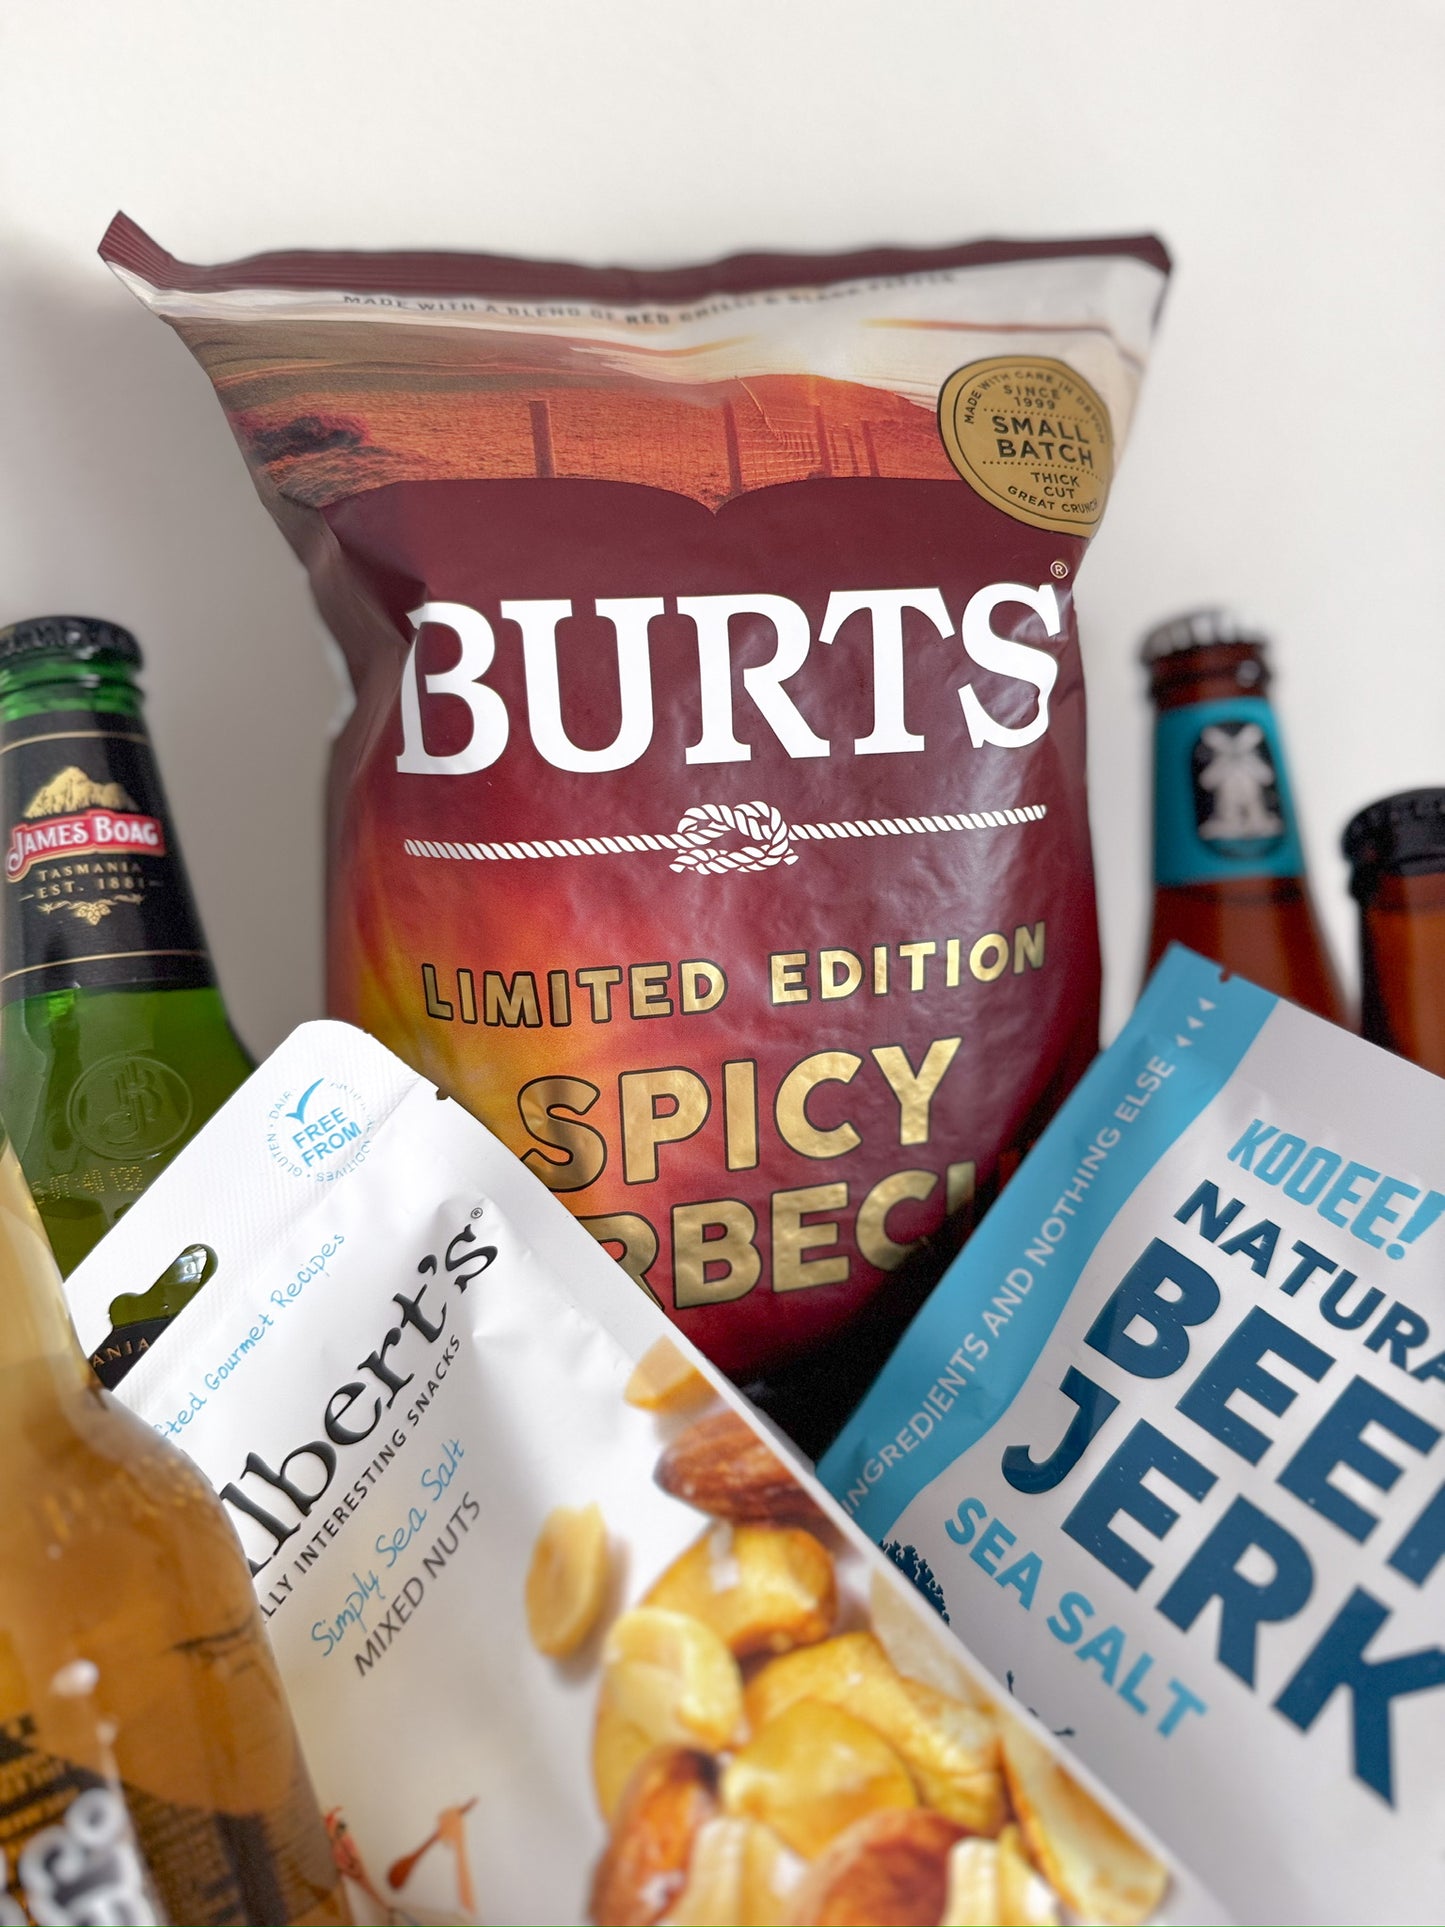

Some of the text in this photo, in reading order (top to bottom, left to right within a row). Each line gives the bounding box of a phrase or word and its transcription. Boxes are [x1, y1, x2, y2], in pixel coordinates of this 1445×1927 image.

[343, 295, 409, 310] MADE
[418, 302, 475, 312] WITH
[485, 304, 499, 313] A
[626, 312, 670, 325] RED
[964, 390, 982, 425] MADE
[978, 371, 1011, 391] WITH
[1014, 371, 1053, 382] CARE
[1058, 380, 1074, 395] IN
[1003, 384, 1061, 400] SINCE
[1014, 396, 1056, 410] 1999
[992, 414, 1090, 445] SMALL
[996, 438, 1094, 469] BATCH
[1007, 485, 1099, 515] GREAT CRUNCH
[1030, 471, 1080, 487] THICK
[1043, 486, 1075, 500] CUT
[396, 581, 1062, 776] BURTS
[6, 815, 159, 872] JAMES BOAG
[37, 876, 146, 899] EST. 1881
[38, 861, 143, 882] TASMANIA
[420, 920, 1047, 1028] LIMITED EDITION
[269, 1087, 297, 1120] DAIR
[517, 1036, 963, 1192] SPICY
[292, 1106, 349, 1150] FREE
[301, 1120, 362, 1168] FROM
[266, 1132, 302, 1178] GLUTEN
[1227, 1118, 1445, 1261] KOOEE!
[840, 1054, 1176, 1517] INGREDIENTS AND NOTHING ELSE
[204, 1312, 275, 1391] Gourmet
[270, 1234, 346, 1309] Recipes
[92, 1336, 150, 1368] ANIA
[219, 1223, 499, 1577] lbert's
[260, 1334, 461, 1624] LLY INTERESTING SNACKS
[311, 1438, 465, 1657] Simply Sea Salt
[353, 1490, 482, 1677] MIXED NUTS
[1000, 1365, 1445, 1812] JERK
[944, 1496, 1208, 1740] SEA SALT
